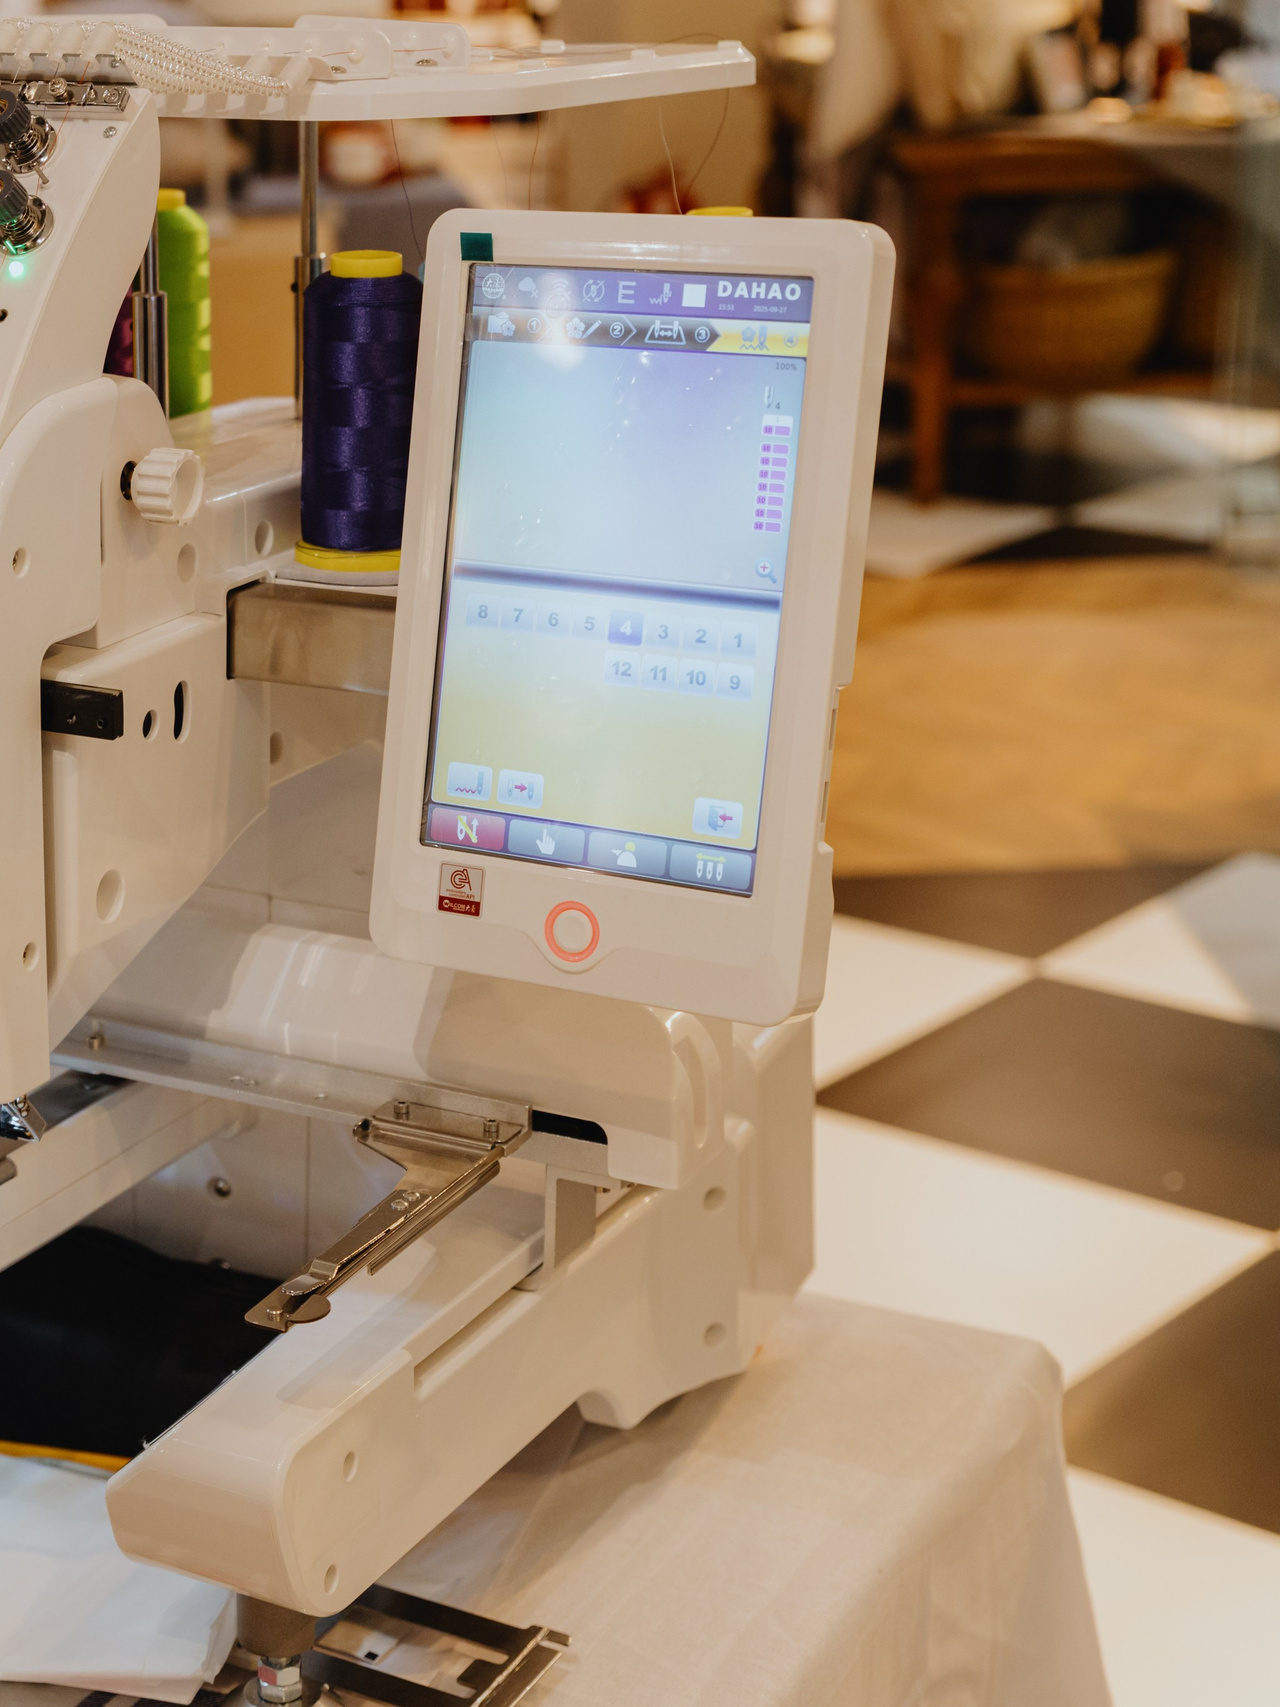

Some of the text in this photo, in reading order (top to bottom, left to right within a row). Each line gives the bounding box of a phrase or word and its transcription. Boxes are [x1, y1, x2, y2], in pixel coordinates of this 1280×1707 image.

[717, 280, 802, 301] DAHAO
[718, 304, 735, 312] 15:51
[775, 362, 797, 371] 100%
[774, 402, 781, 410] 4
[477, 604, 743, 648] 8 7 6 5 4 3 2 1
[612, 661, 741, 690] 12 11 10 9
